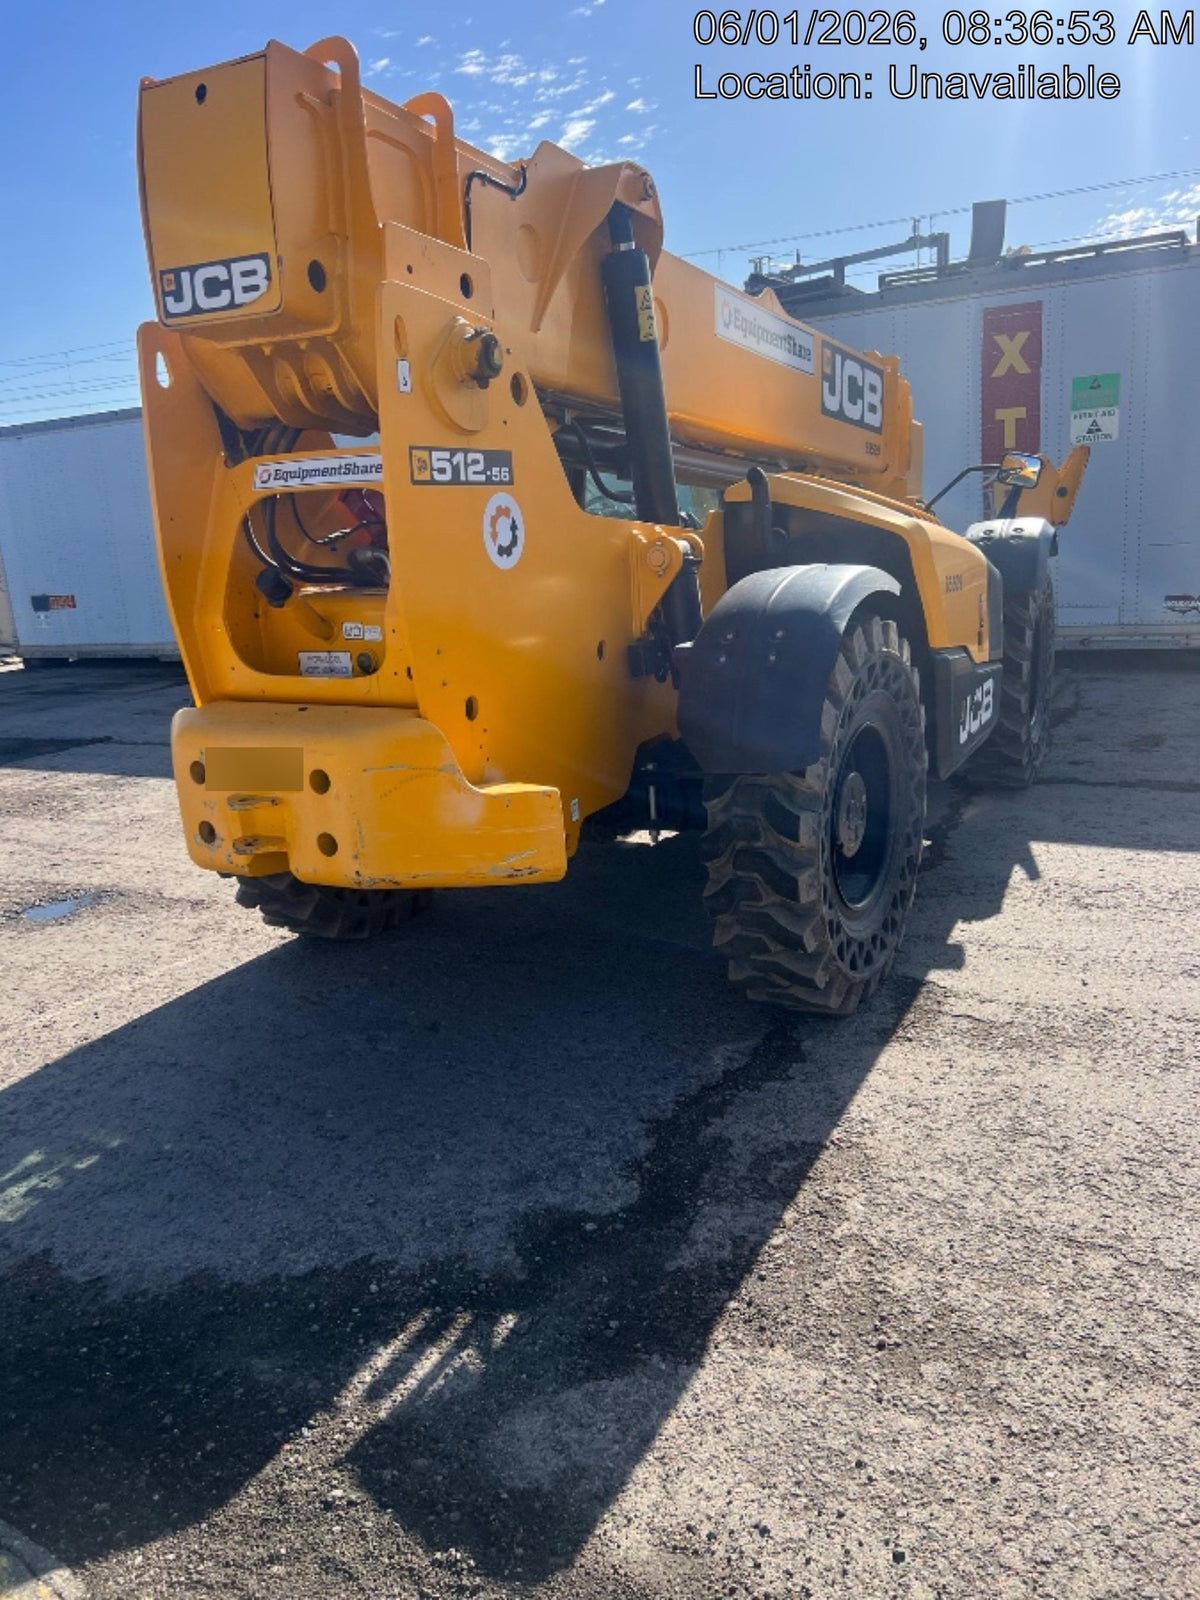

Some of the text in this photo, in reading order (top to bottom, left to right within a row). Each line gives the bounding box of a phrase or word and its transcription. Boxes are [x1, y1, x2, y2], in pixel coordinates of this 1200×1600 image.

[164, 258, 269, 314] JCB
[733, 306, 812, 362] EquipmentShare
[822, 352, 883, 428] JCB
[1075, 433, 1112, 443] STATION
[273, 462, 383, 481] EquipmentShare
[959, 677, 994, 744] JCB
